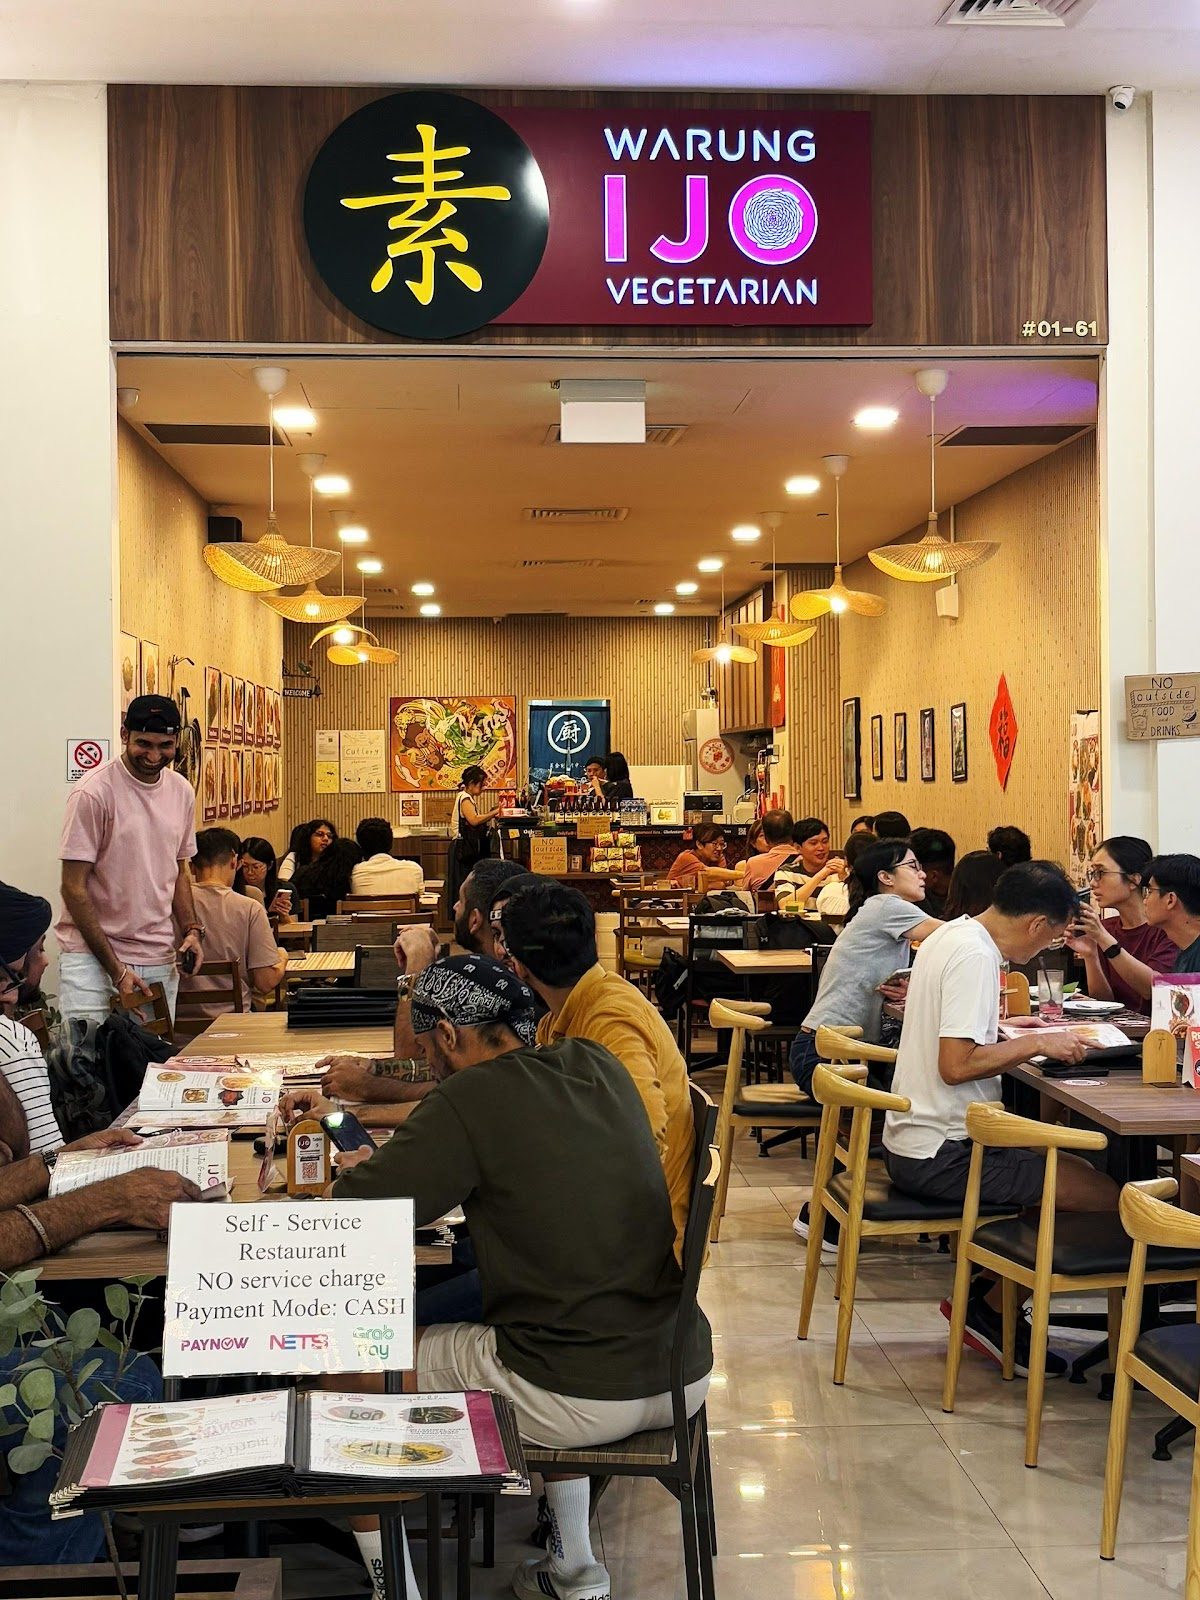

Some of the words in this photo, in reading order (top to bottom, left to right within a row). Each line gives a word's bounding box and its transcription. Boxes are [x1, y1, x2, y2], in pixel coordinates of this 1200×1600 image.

[604, 128, 816, 162] WARUNG
[340, 124, 512, 305] 素
[604, 174, 818, 265] IJO
[606, 278, 818, 305] VEGETARIAN
[1022, 320, 1097, 337] #01-61
[1151, 677, 1173, 689] NO
[1136, 690, 1190, 701] outside
[1152, 706, 1175, 716] FOOD
[1150, 725, 1181, 737] DRINKS
[225, 1213, 269, 1233] Self
[287, 1212, 362, 1232] Service
[239, 1243, 347, 1261] Restaurant
[197, 1272, 233, 1290] NO
[241, 1270, 312, 1289] service
[319, 1269, 386, 1291] charge
[175, 1302, 265, 1324] Payment
[272, 1299, 337, 1317] Mode:
[345, 1298, 406, 1315] CASH
[353, 1325, 394, 1340] Grab
[181, 1337, 249, 1351] PAYNOW
[270, 1334, 328, 1350] NETS
